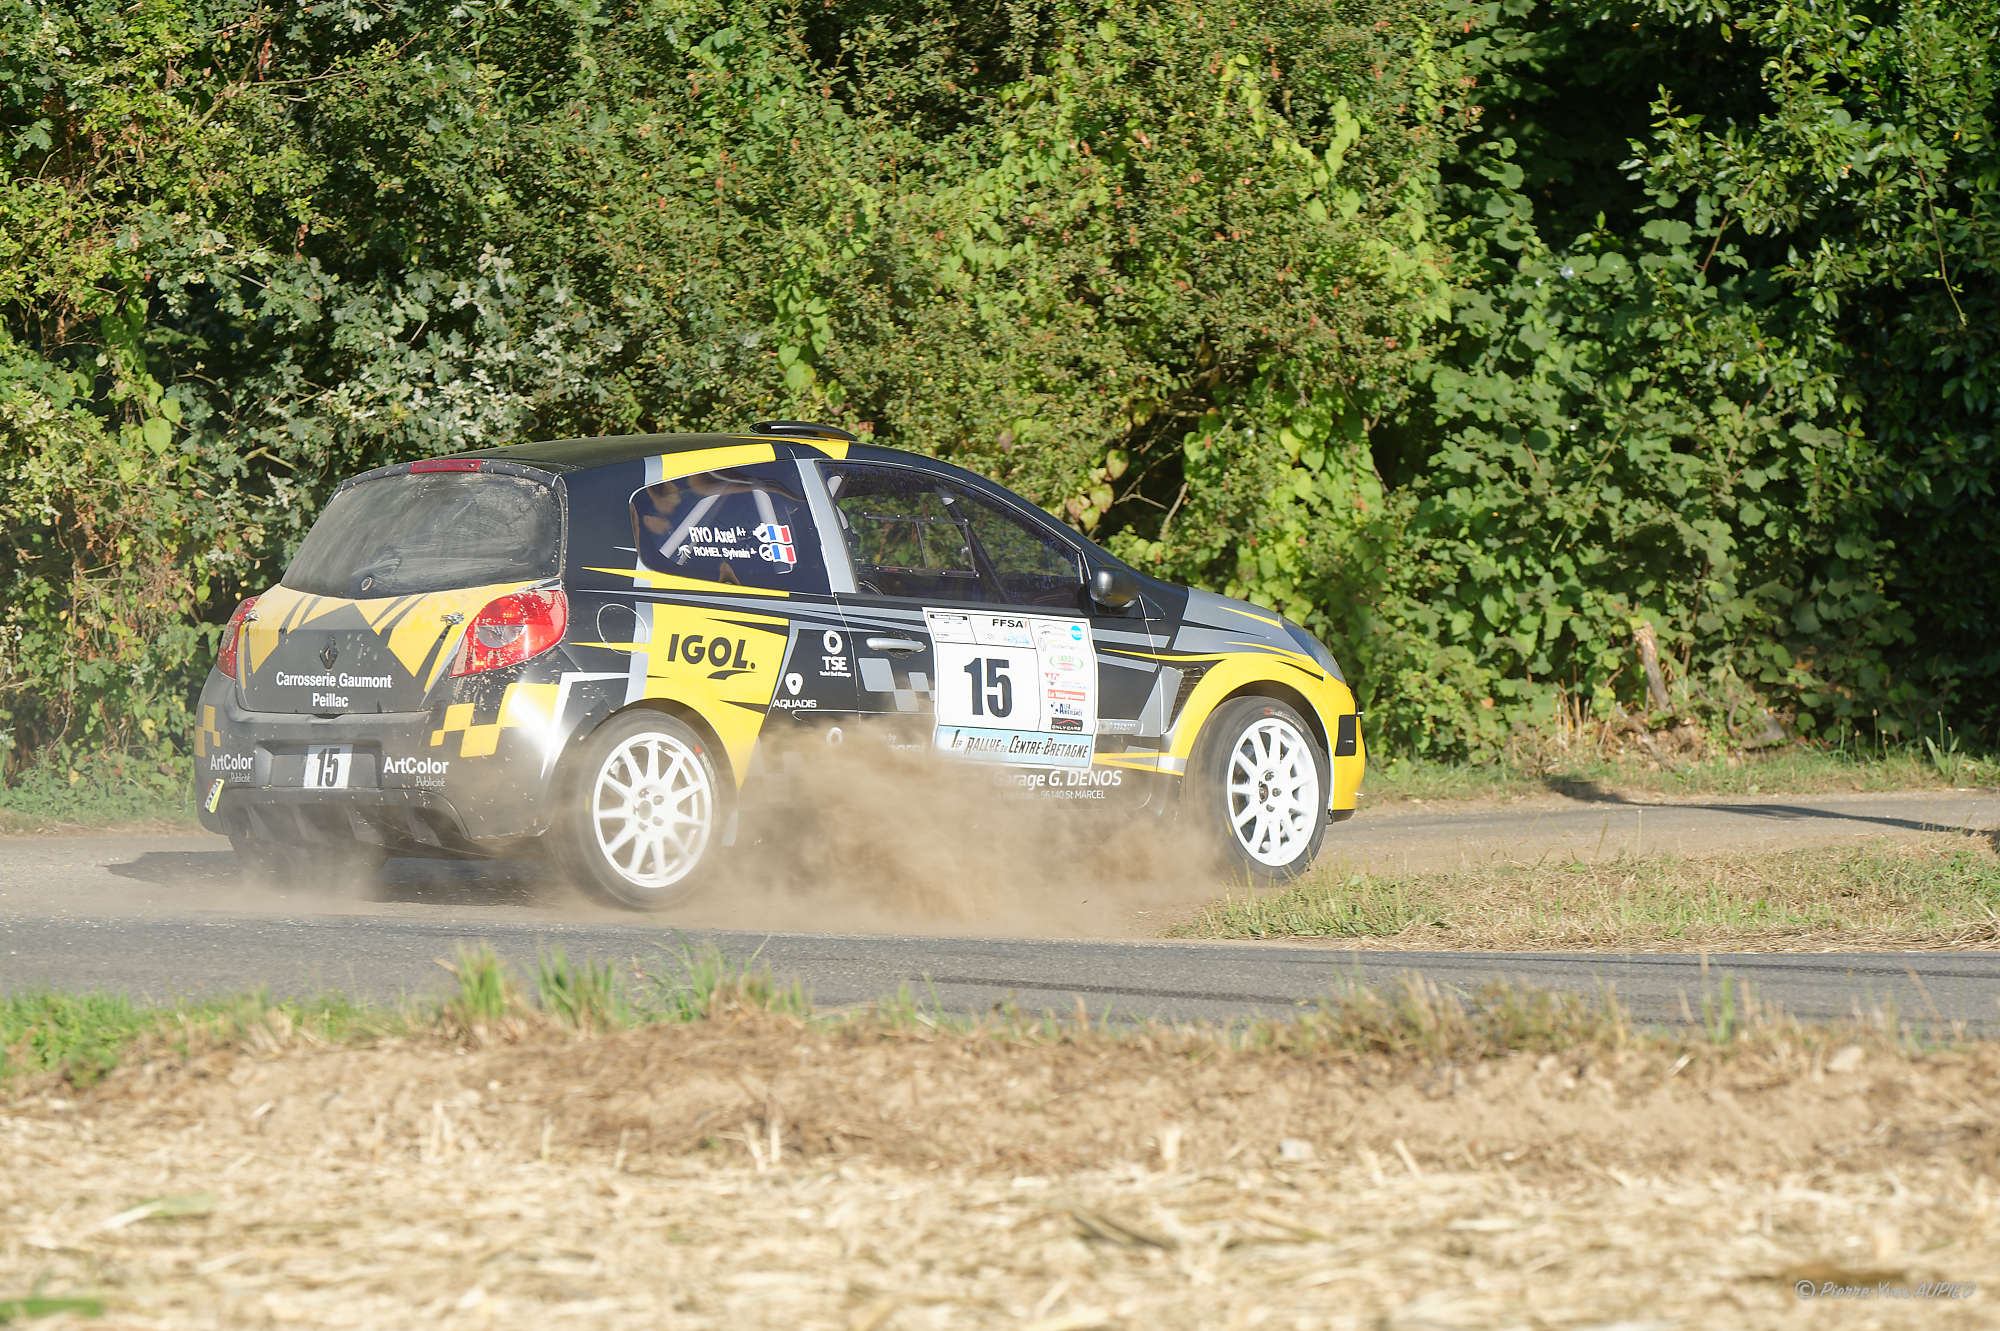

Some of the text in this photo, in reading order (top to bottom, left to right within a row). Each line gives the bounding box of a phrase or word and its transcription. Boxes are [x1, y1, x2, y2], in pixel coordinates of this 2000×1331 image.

[689, 526, 712, 543] RYO
[714, 527, 737, 544] Axel
[693, 546, 722, 558] ROHEL
[723, 547, 751, 560] Sylvain
[992, 618, 1024, 629] FFSA
[822, 655, 848, 671] TSE
[275, 671, 392, 690] Carrosserie Gaumont
[963, 657, 1014, 719] 15
[311, 692, 349, 708] Peillac
[772, 698, 817, 710] AQUADIS
[1008, 735, 1089, 759] CENTRE-BRETAGNE
[210, 753, 254, 771] ArtColor
[316, 747, 341, 788] 15
[383, 757, 450, 774] ArtColor
[1048, 771, 1064, 787] G.
[1066, 770, 1122, 787] DENOS
[1075, 790, 1105, 800] MARCEL
